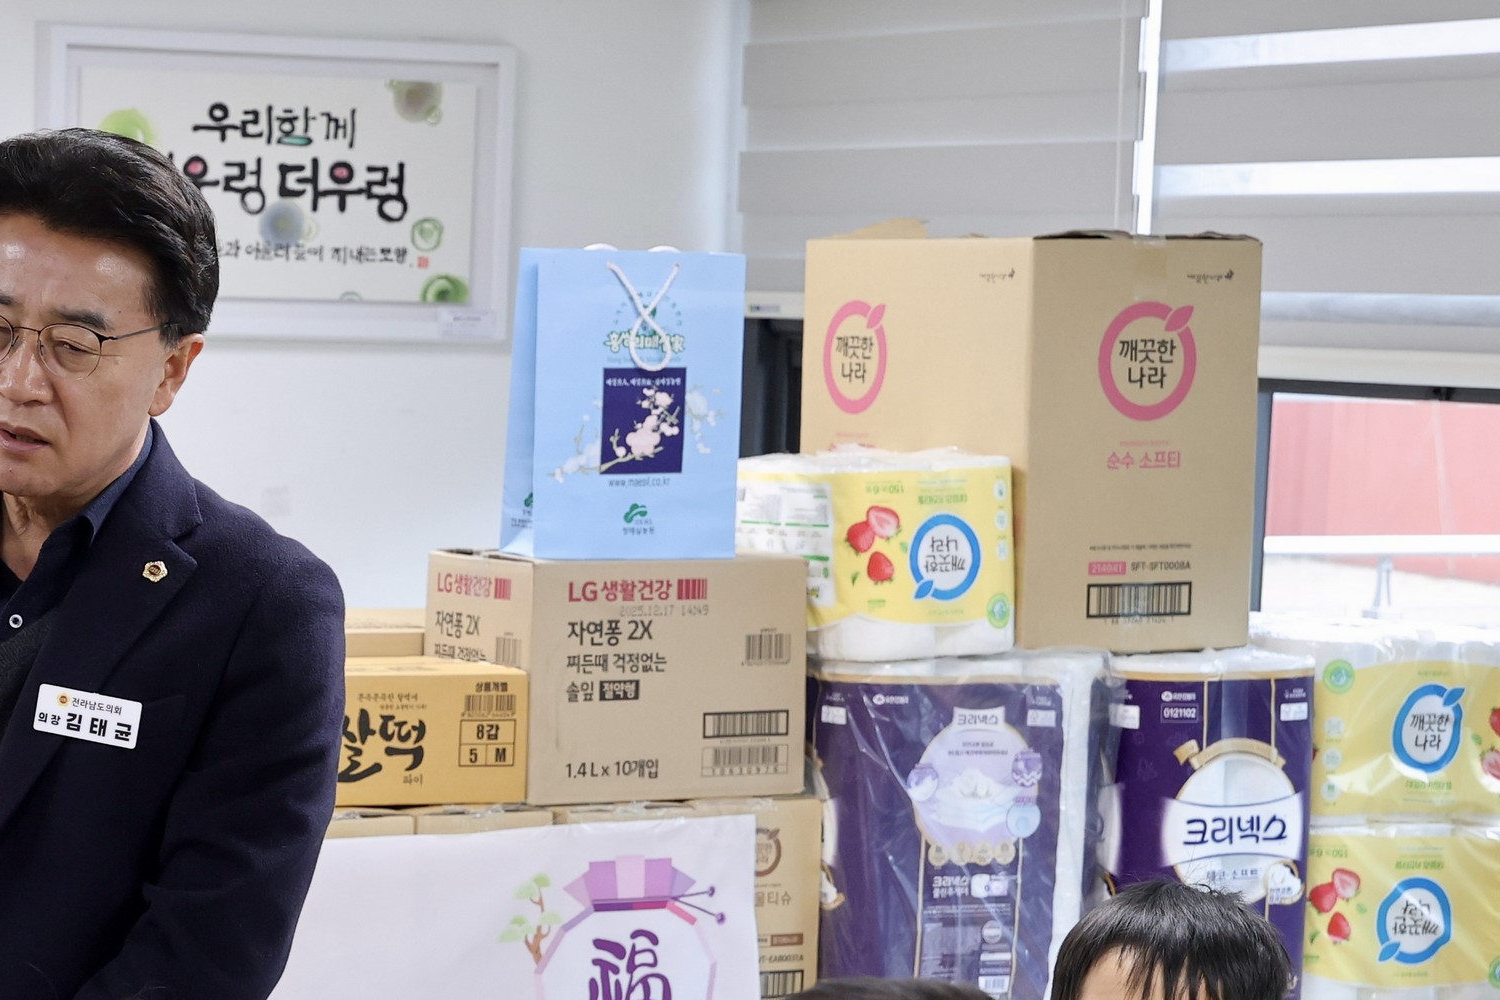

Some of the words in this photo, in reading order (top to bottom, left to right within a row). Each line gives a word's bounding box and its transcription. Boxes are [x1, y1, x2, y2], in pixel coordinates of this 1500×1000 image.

[192, 102, 357, 149] 우리함께
[180, 153, 266, 215] 우렁
[278, 156, 409, 223] 더우렁
[835, 335, 874, 360] 깨끗한
[1118, 337, 1177, 365] 깨끗한
[841, 361, 867, 385] 나라
[1127, 365, 1167, 389] 나라
[1106, 450, 1135, 470] 순수
[1138, 450, 1181, 469] 소프티
[929, 535, 958, 553] 나라
[923, 554, 967, 574] 깨끗한
[620, 604, 675, 618] 2025.12.17
[435, 610, 463, 639] 자연퐁
[465, 614, 481, 636] 2X
[567, 619, 623, 647] 자연퐁
[627, 619, 653, 641] 2X
[566, 653, 609, 675] 찌든때
[612, 652, 668, 674] 걱정없는
[475, 681, 509, 693] 상품개별
[566, 680, 594, 703] 솔잎
[602, 681, 636, 700] 절약형
[71, 697, 123, 716] 전라남도의회
[37, 711, 61, 726] 의장
[66, 712, 132, 742] 김태균
[476, 723, 501, 741] 8갑
[1409, 712, 1450, 733] 깨끗한
[1414, 733, 1442, 751] 나라
[469, 748, 478, 764] 5
[495, 747, 506, 763] M
[565, 762, 587, 779] 1.4
[614, 758, 659, 780] 10개입
[1182, 814, 1288, 846] 크리넥스
